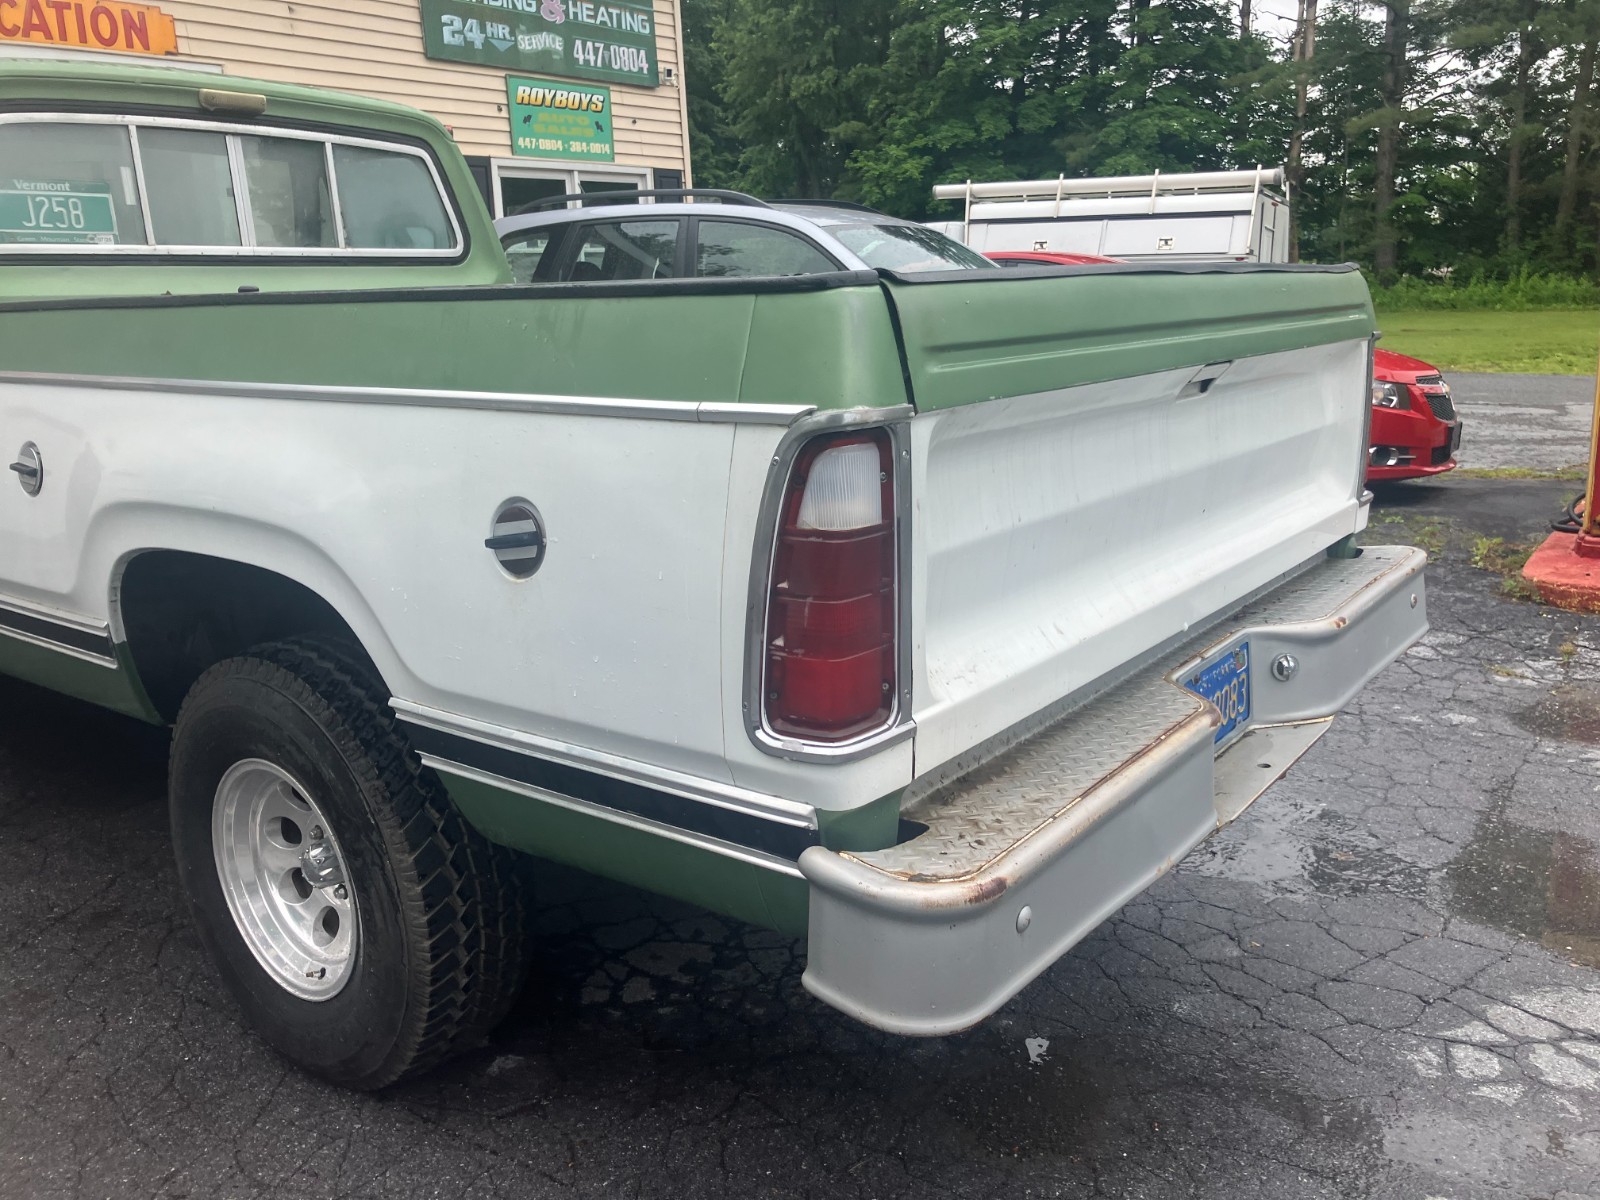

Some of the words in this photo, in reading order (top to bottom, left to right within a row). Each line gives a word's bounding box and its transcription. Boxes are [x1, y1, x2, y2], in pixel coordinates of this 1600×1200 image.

[441, 14, 486, 50] 24
[485, 21, 515, 40] HR.
[516, 31, 564, 51] SERVICE
[568, 5, 650, 34] HEATING
[516, 85, 604, 112] ROYBOYS
[13, 179, 71, 191] Vermont
[21, 195, 84, 229] J258
